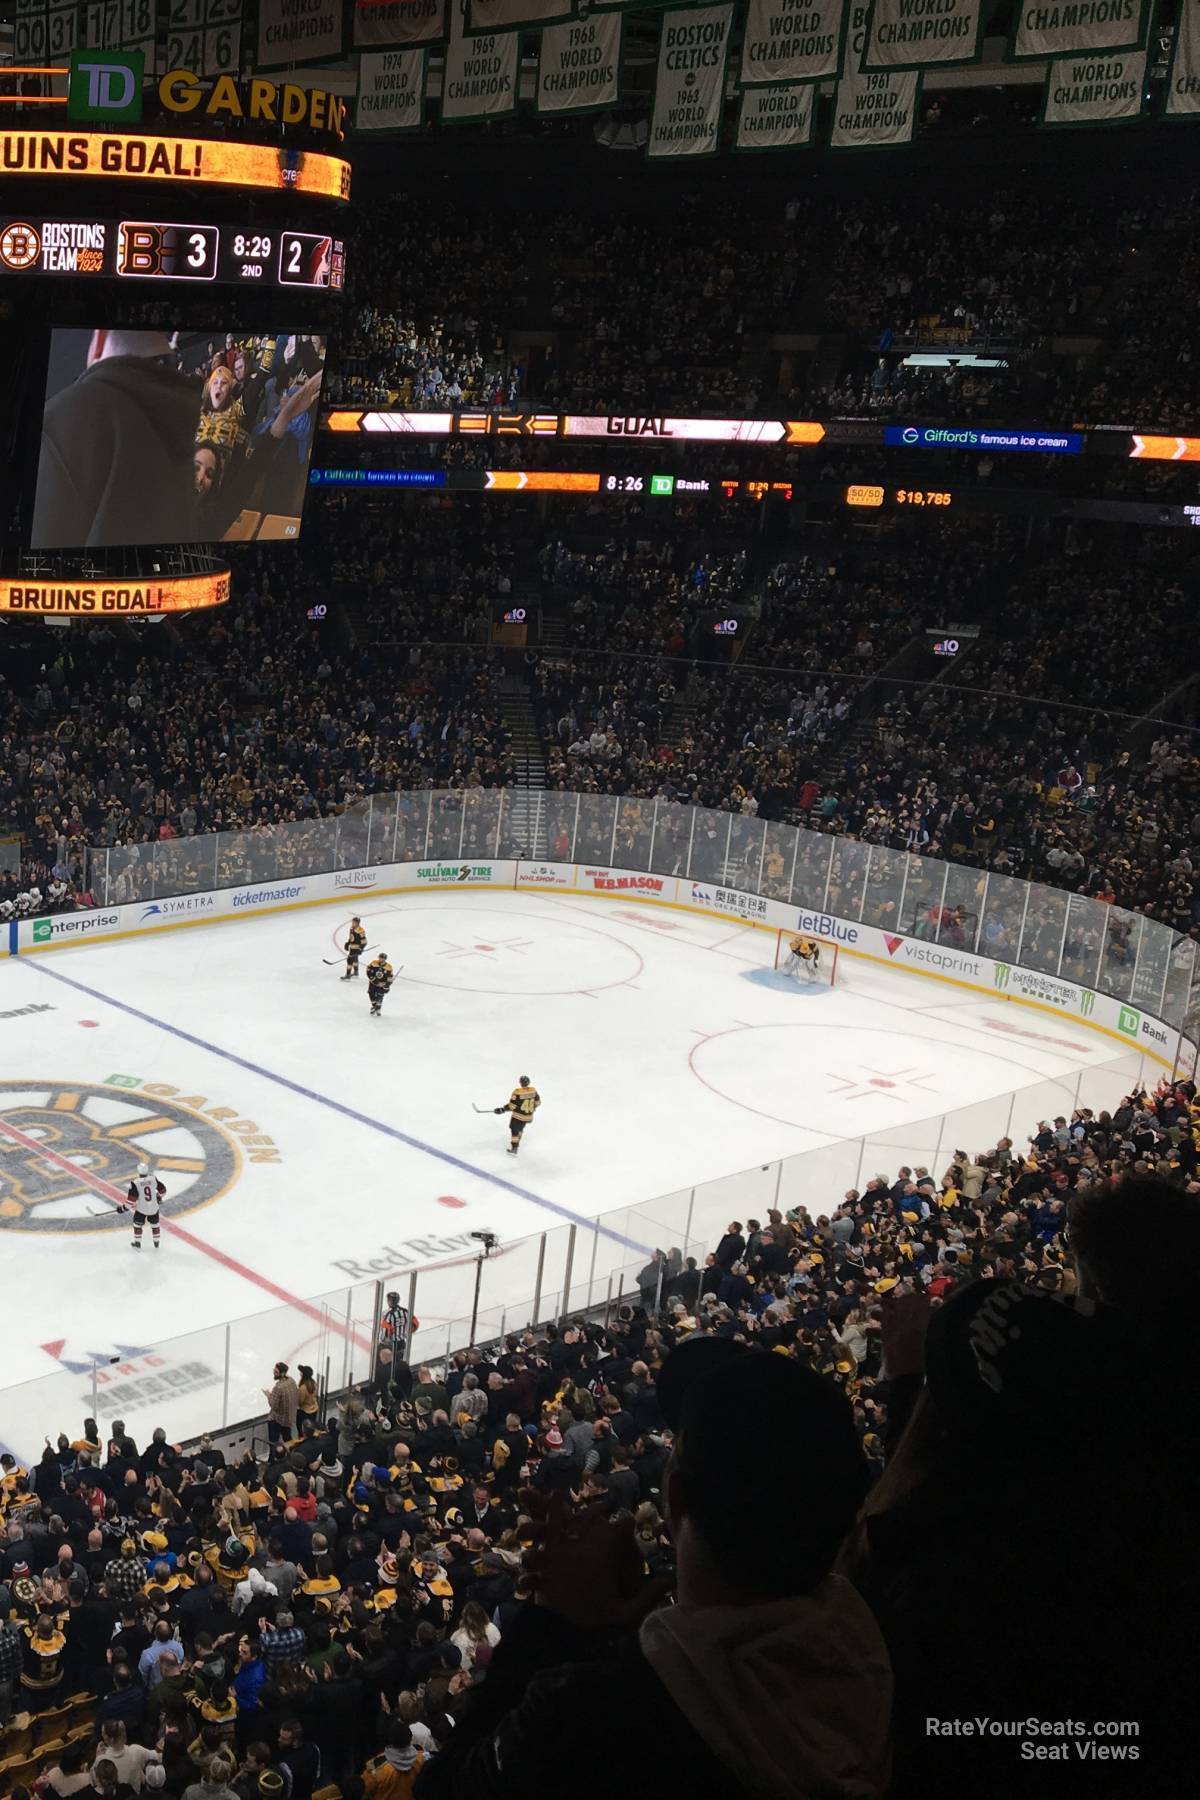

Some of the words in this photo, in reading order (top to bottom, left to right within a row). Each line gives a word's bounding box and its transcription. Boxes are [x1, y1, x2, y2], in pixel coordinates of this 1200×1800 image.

[769, 13, 821, 36] WORLD
[1026, 1, 1133, 31] CHAMPIONS
[16, 19, 45, 55] 00
[52, 13, 74, 55] 31
[266, 15, 335, 44] CHAMPIONS
[569, 25, 595, 47] 1968
[666, 22, 725, 48] BOSTON
[877, 16, 970, 44] CHAMPIONS
[170, 37, 201, 75] 24
[216, 31, 231, 68] 6
[472, 37, 495, 56] 1969
[749, 34, 835, 62] CHAMPIONS
[382, 55, 403, 70] 1974
[463, 57, 502, 77] WORLD
[560, 47, 602, 70] WORLD
[666, 45, 720, 70] CELTICS
[374, 73, 408, 91] WORLD
[543, 65, 614, 92] CHAMPIONS
[866, 75, 890, 91] 1961
[1072, 62, 1123, 83] WORLD
[448, 75, 511, 99] CHAMPIONS
[677, 89, 700, 105] 1963
[1054, 82, 1137, 104] CHAMPIONS
[78, 64, 135, 108] TD
[159, 69, 343, 133] GARDEN
[360, 91, 416, 112] CHAMPIONS
[758, 95, 798, 113] WORLD
[855, 92, 898, 110] WORLD
[668, 106, 705, 123] WORLD
[838, 110, 908, 130] CHAMPIONS
[655, 122, 715, 141] CHAMPIONS
[101, 140, 202, 177] GOAL!
[77, 249, 103, 259] Since
[188, 233, 206, 268] 3
[234, 235, 271, 257] 8:29
[42, 248, 77, 271] TEAM
[78, 260, 103, 272] 1924
[288, 241, 302, 273] 2
[242, 264, 262, 277] 2ND
[607, 417, 673, 437] GOAL
[925, 430, 977, 445] Gifford's
[980, 434, 1018, 446] famous
[1020, 436, 1035, 446] ice
[1037, 438, 1067, 448] cream
[607, 476, 644, 490] 8:26
[655, 479, 671, 491] TD
[676, 479, 709, 491] Bank
[897, 490, 951, 507] $19,785
[315, 604, 327, 616] 10
[513, 608, 526, 620] 10
[725, 619, 738, 631] 10
[943, 640, 959, 652] 10
[417, 863, 458, 877] SULLIVAN
[471, 866, 492, 877] TIRE
[163, 897, 214, 913] SYMETRA
[232, 886, 303, 907] ticketmaster
[38, 914, 118, 936] enterprise
[797, 910, 858, 943] jetBlue
[905, 944, 981, 976] vistaprint
[1012, 972, 1078, 1002] MONSTER
[1122, 1010, 1137, 1032] TD
[1142, 1021, 1167, 1045] Bank
[144, 1186, 152, 1202] 9
[330, 1246, 415, 1279] Red
[401, 1226, 492, 1258] Riv
